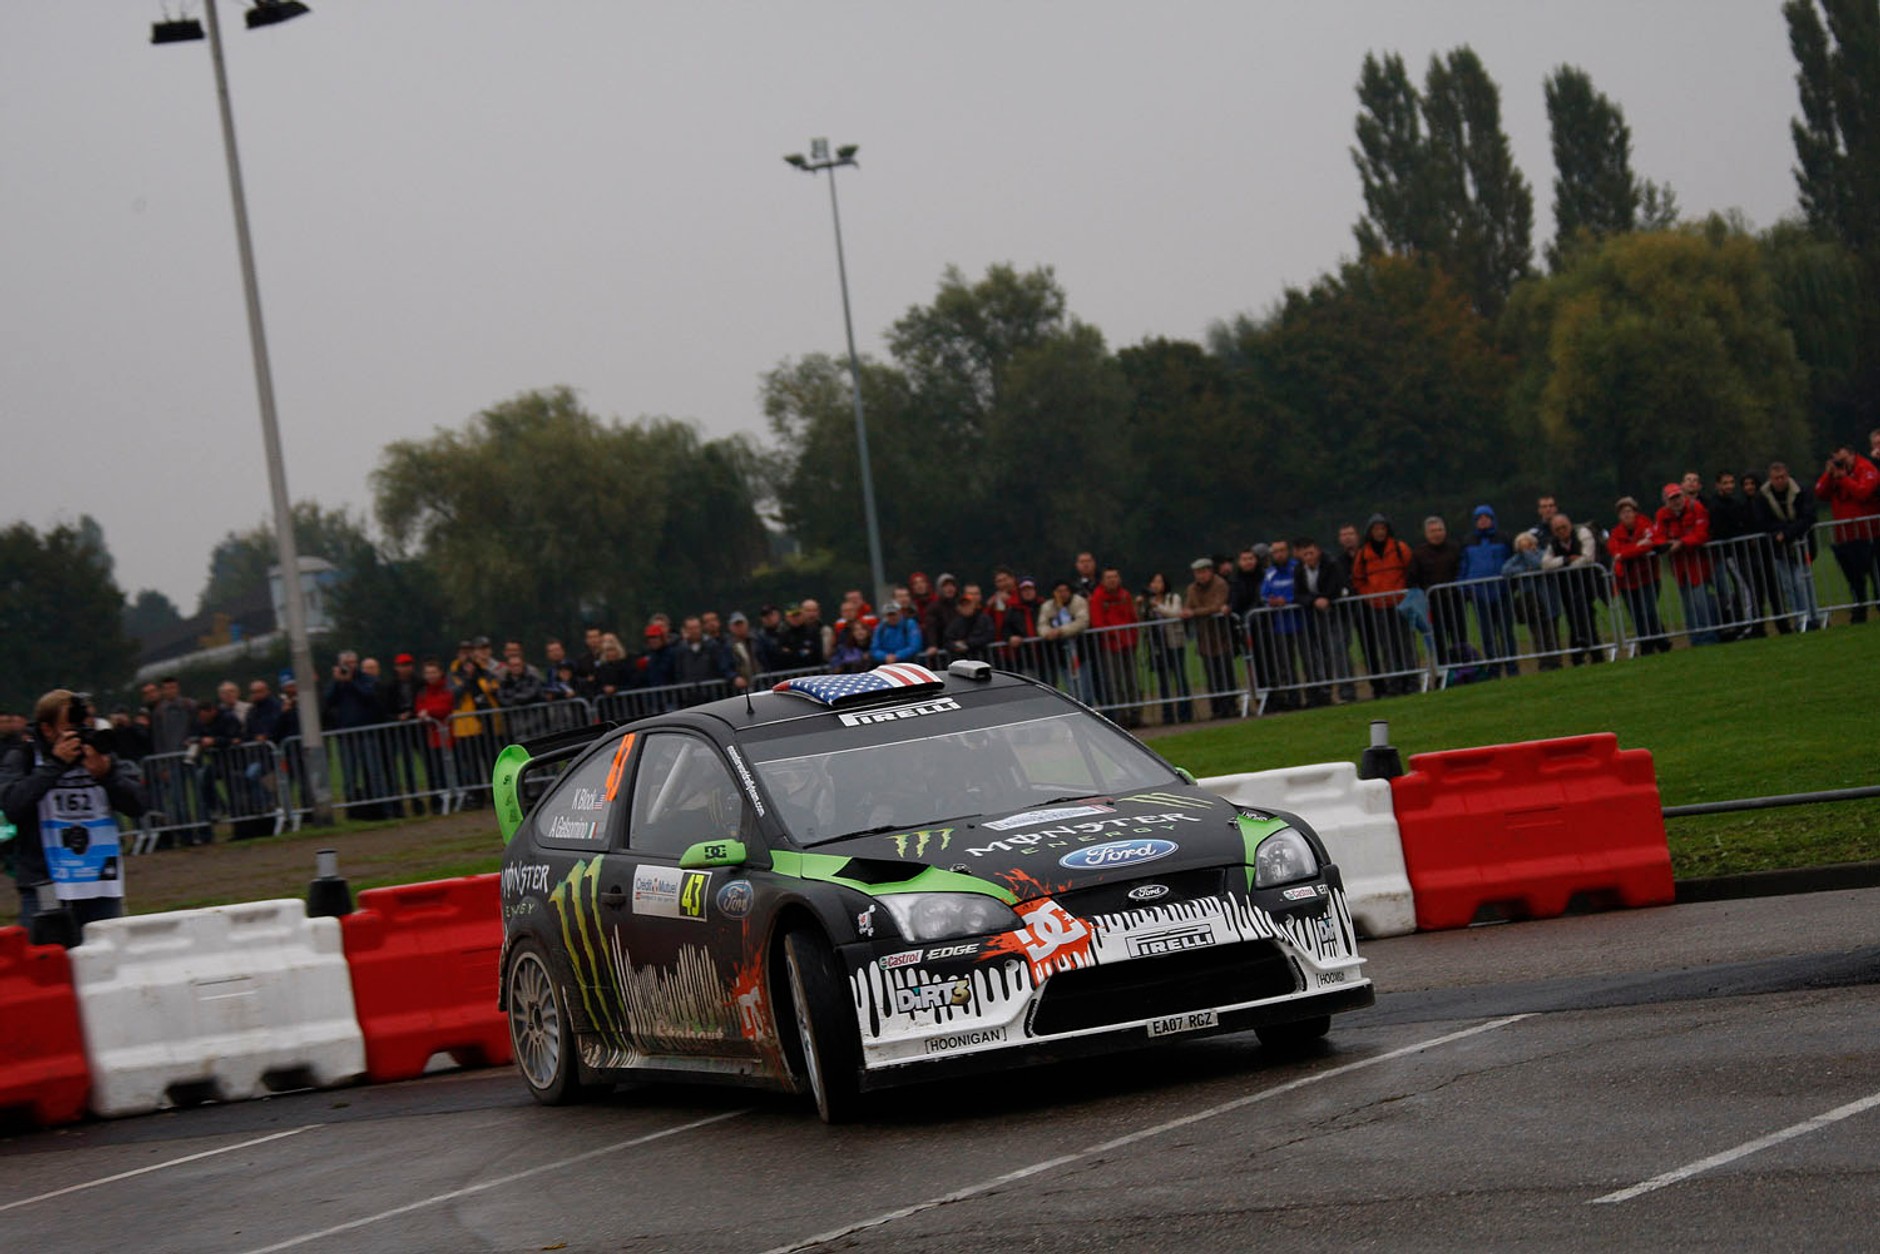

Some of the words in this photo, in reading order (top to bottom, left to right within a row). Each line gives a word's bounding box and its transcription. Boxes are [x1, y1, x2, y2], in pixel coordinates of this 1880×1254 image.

[838, 697, 961, 727] PIRELLI
[965, 812, 1202, 858] MONSTER
[1020, 824, 1177, 856] ENERGY
[1085, 842, 1158, 866] Ford
[501, 860, 550, 899] MONSTER
[681, 874, 705, 917] 43
[723, 885, 748, 912] Ford
[886, 952, 921, 968] Castrol
[925, 943, 980, 961] EDGE
[1125, 924, 1216, 959] PIRELLI
[1153, 1017, 1183, 1035] EA07
[1188, 1012, 1213, 1027] RGZ
